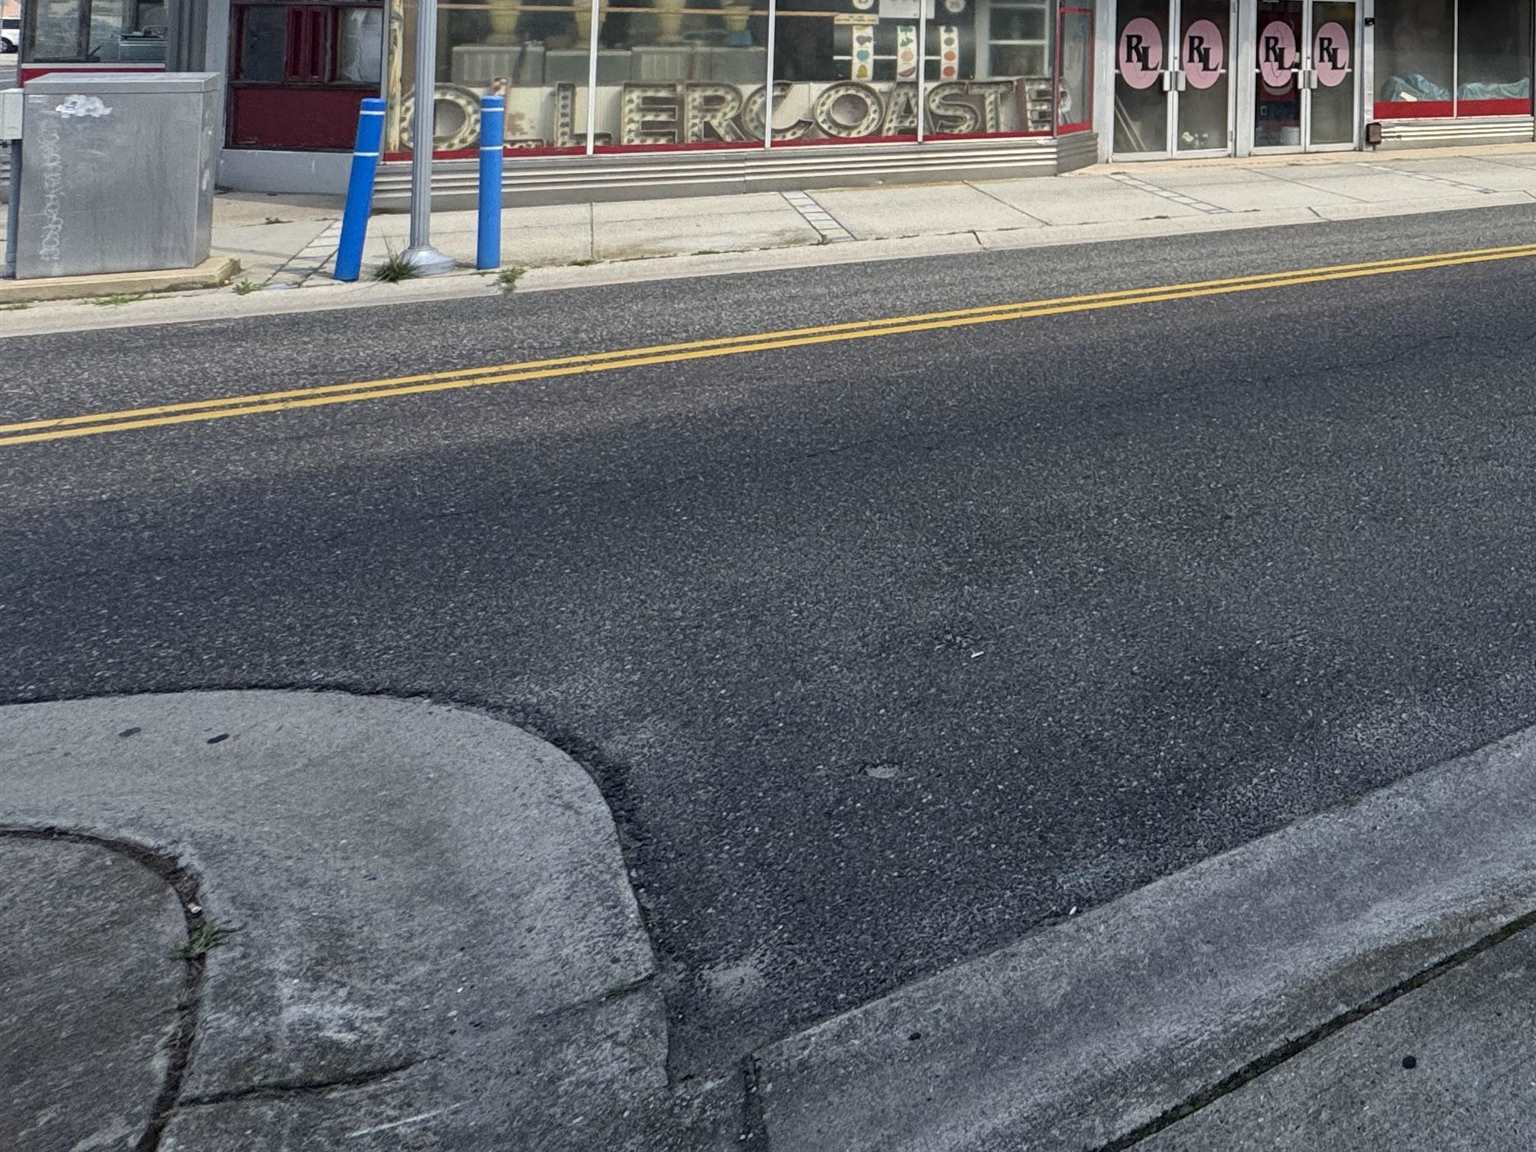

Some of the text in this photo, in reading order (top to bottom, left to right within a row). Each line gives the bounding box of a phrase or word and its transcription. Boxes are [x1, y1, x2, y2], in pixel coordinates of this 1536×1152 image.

[1125, 34, 1160, 72] RL
[1187, 35, 1220, 73] RL
[1263, 36, 1295, 71] RL
[1318, 36, 1348, 71] RL
